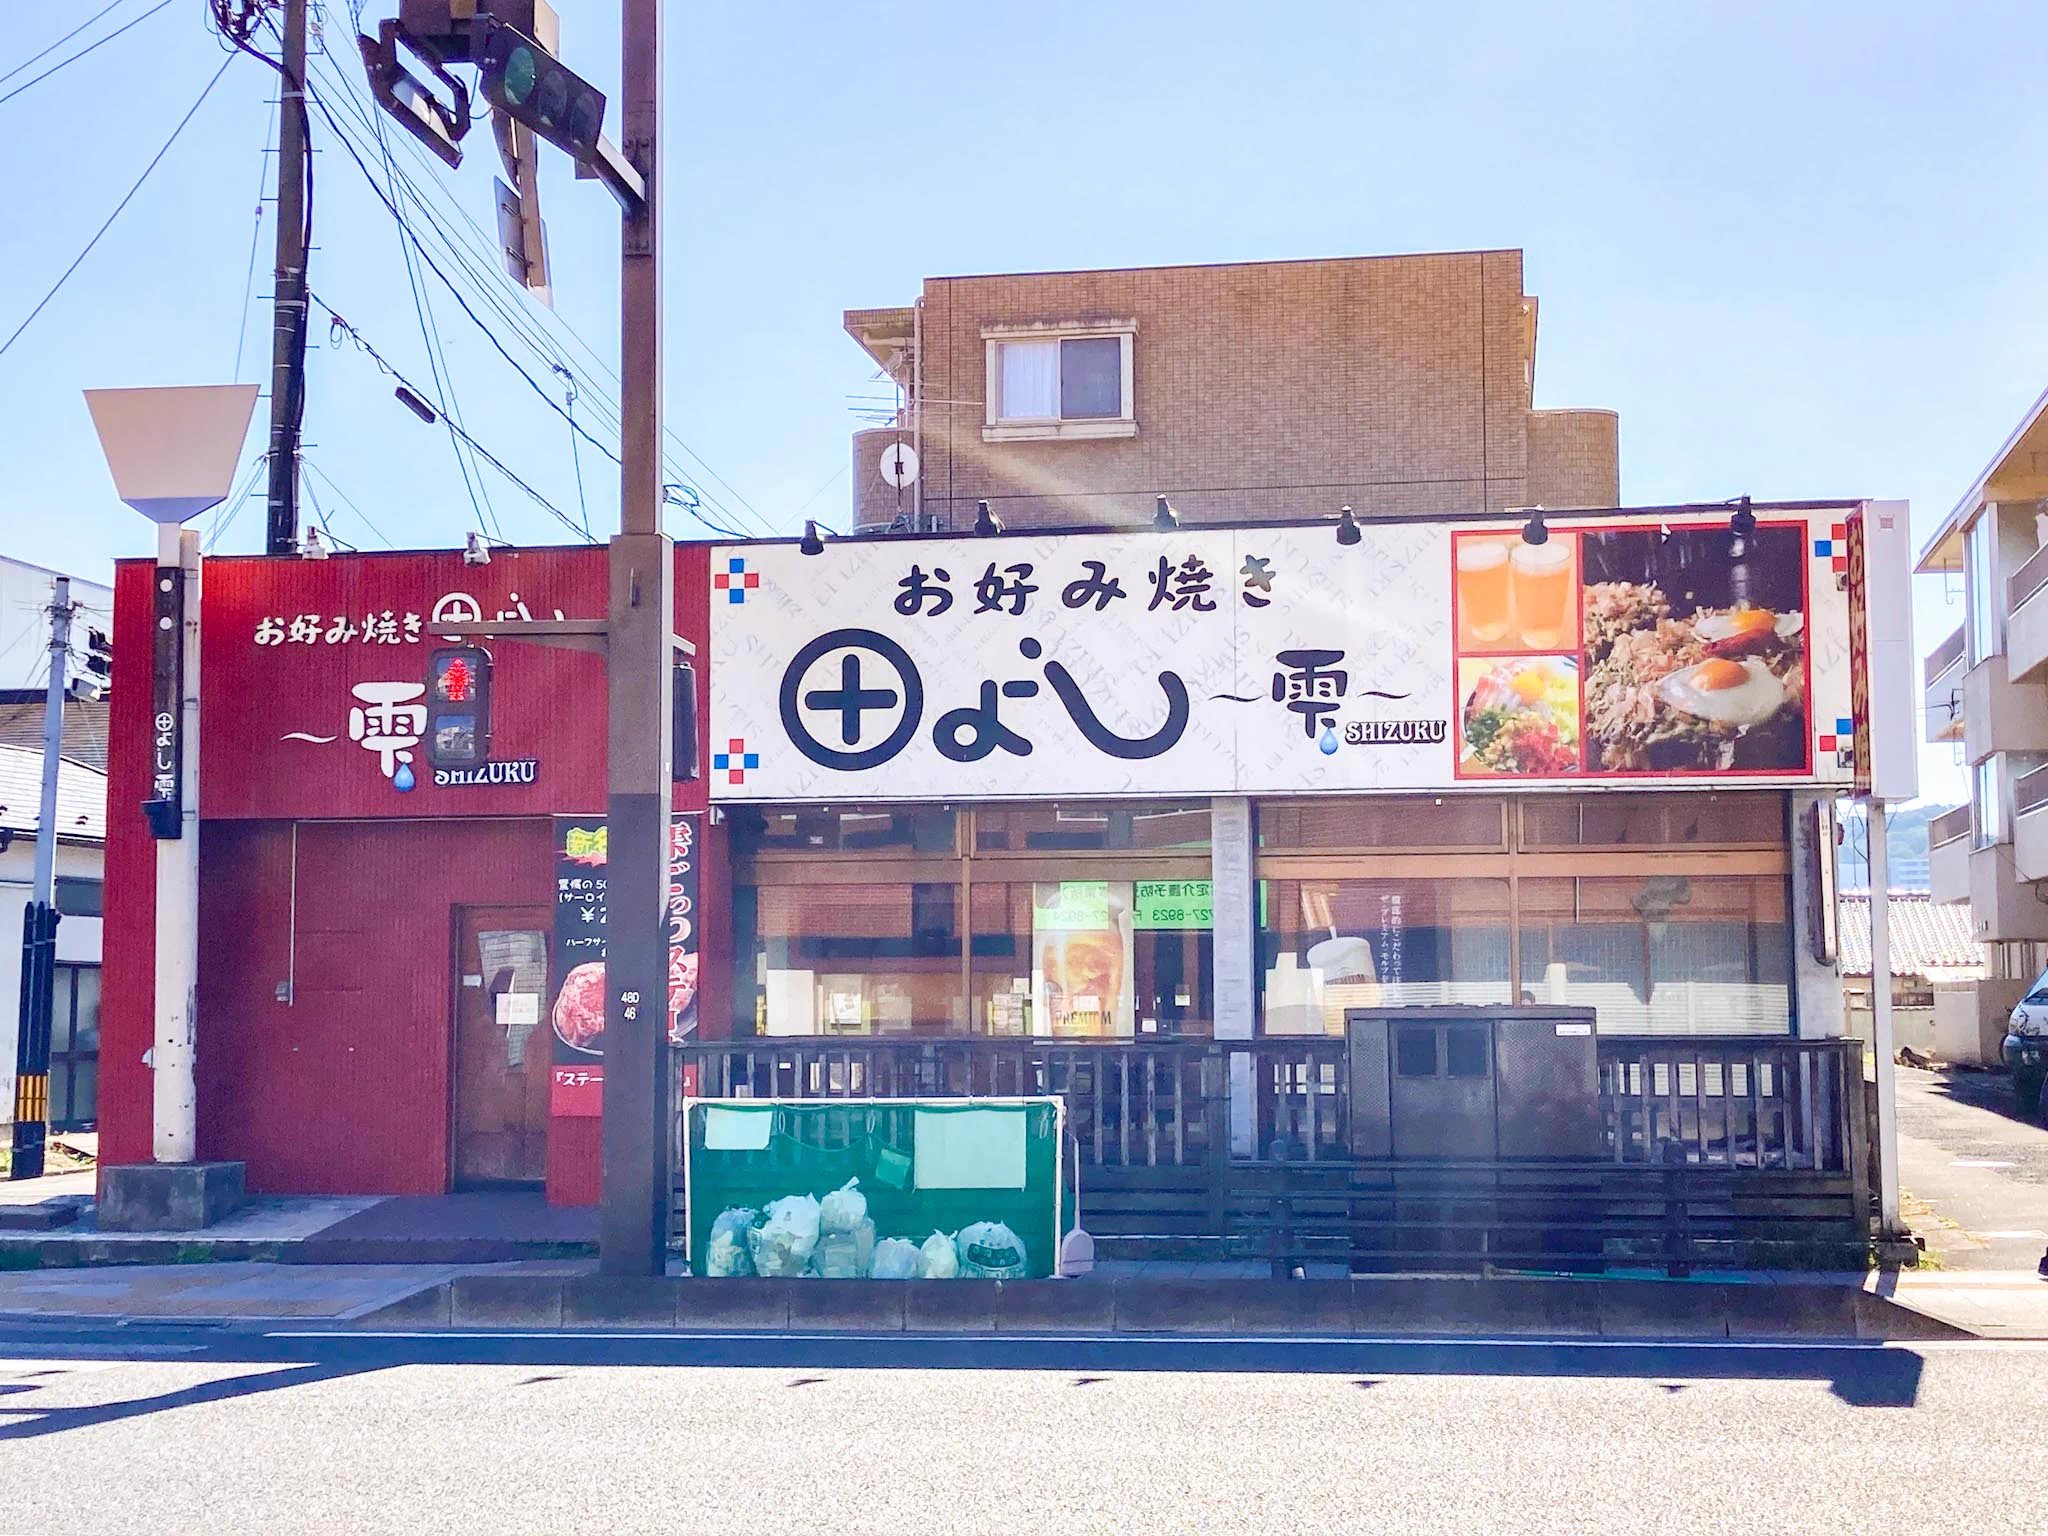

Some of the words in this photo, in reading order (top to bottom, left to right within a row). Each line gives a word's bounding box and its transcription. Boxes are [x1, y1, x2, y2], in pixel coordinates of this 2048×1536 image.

[894, 554, 1276, 616] お好み焼き
[254, 610, 424, 646] お好み焼き
[1345, 720, 1446, 745] SHIZUKU
[623, 1006, 637, 1021] 46
